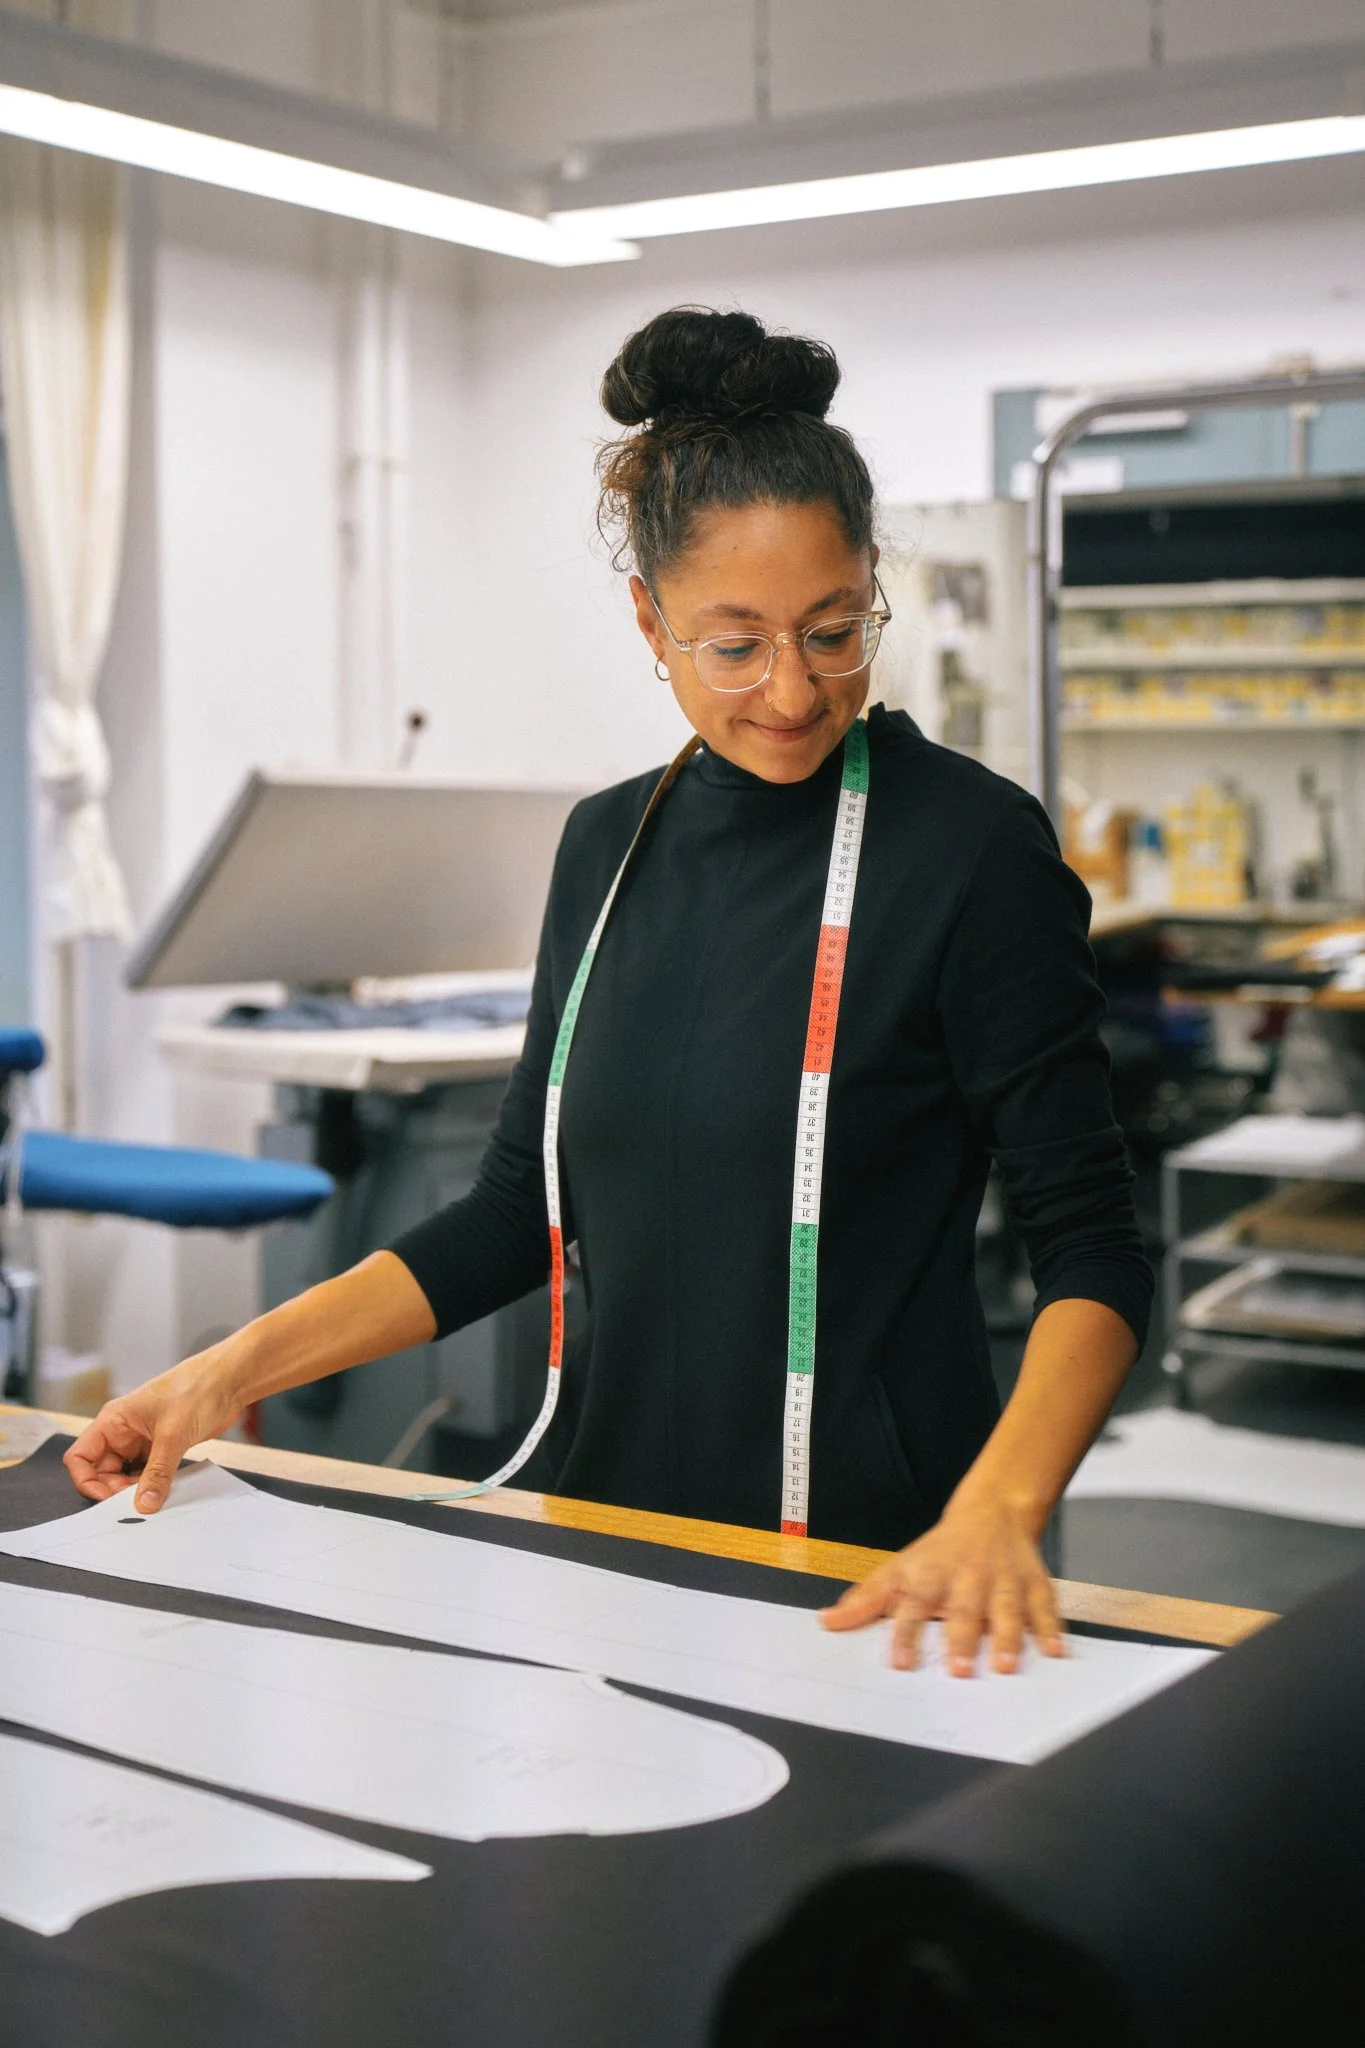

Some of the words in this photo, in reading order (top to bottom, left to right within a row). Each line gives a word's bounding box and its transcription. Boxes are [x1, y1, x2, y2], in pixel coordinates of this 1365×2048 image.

[847, 804, 856, 812] 59
[846, 816, 854, 826] 58
[844, 830, 852, 838] 57
[840, 856, 848, 866] 55
[838, 870, 846, 879] 54
[836, 884, 844, 892] 53
[834, 898, 842, 906] 52
[833, 912, 840, 920] 51
[812, 1072, 820, 1080] 40
[808, 1118, 816, 1126] 37
[806, 1134, 815, 1142] 36
[805, 1148, 814, 1157] 35
[804, 1164, 813, 1172] 34
[803, 1180, 812, 1188] 33
[802, 1194, 811, 1202] 32
[802, 1210, 810, 1218] 31
[796, 1389, 803, 1397] 19
[794, 1404, 802, 1412] 18
[792, 1449, 800, 1457] 15
[792, 1492, 799, 1501] 12
[792, 1508, 798, 1516] 11
